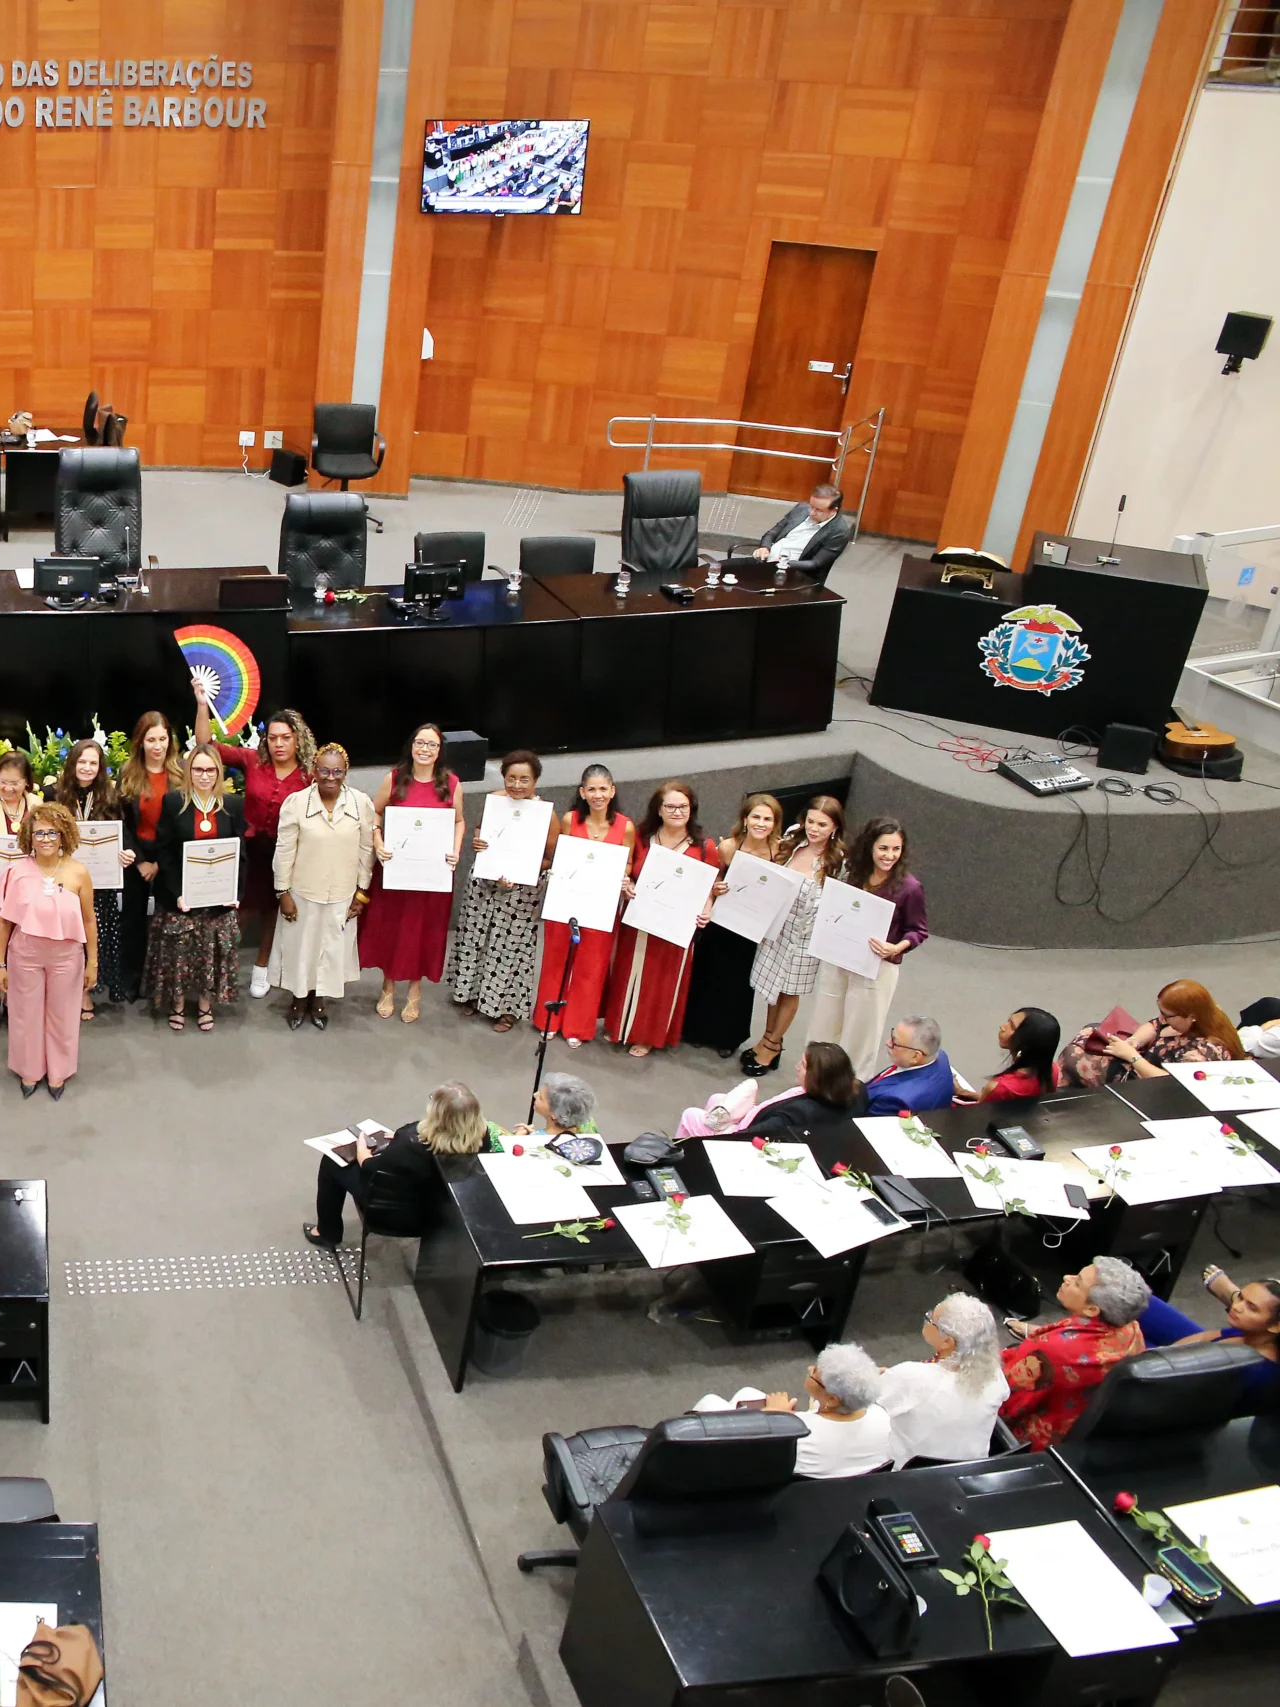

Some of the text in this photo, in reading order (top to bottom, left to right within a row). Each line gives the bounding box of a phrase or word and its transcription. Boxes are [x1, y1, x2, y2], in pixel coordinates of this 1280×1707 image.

[11, 59, 59, 88] DAS
[67, 53, 253, 94] DELIBERAÇÕES
[35, 88, 114, 128] RENÊ
[123, 96, 267, 129] BARBOUR
